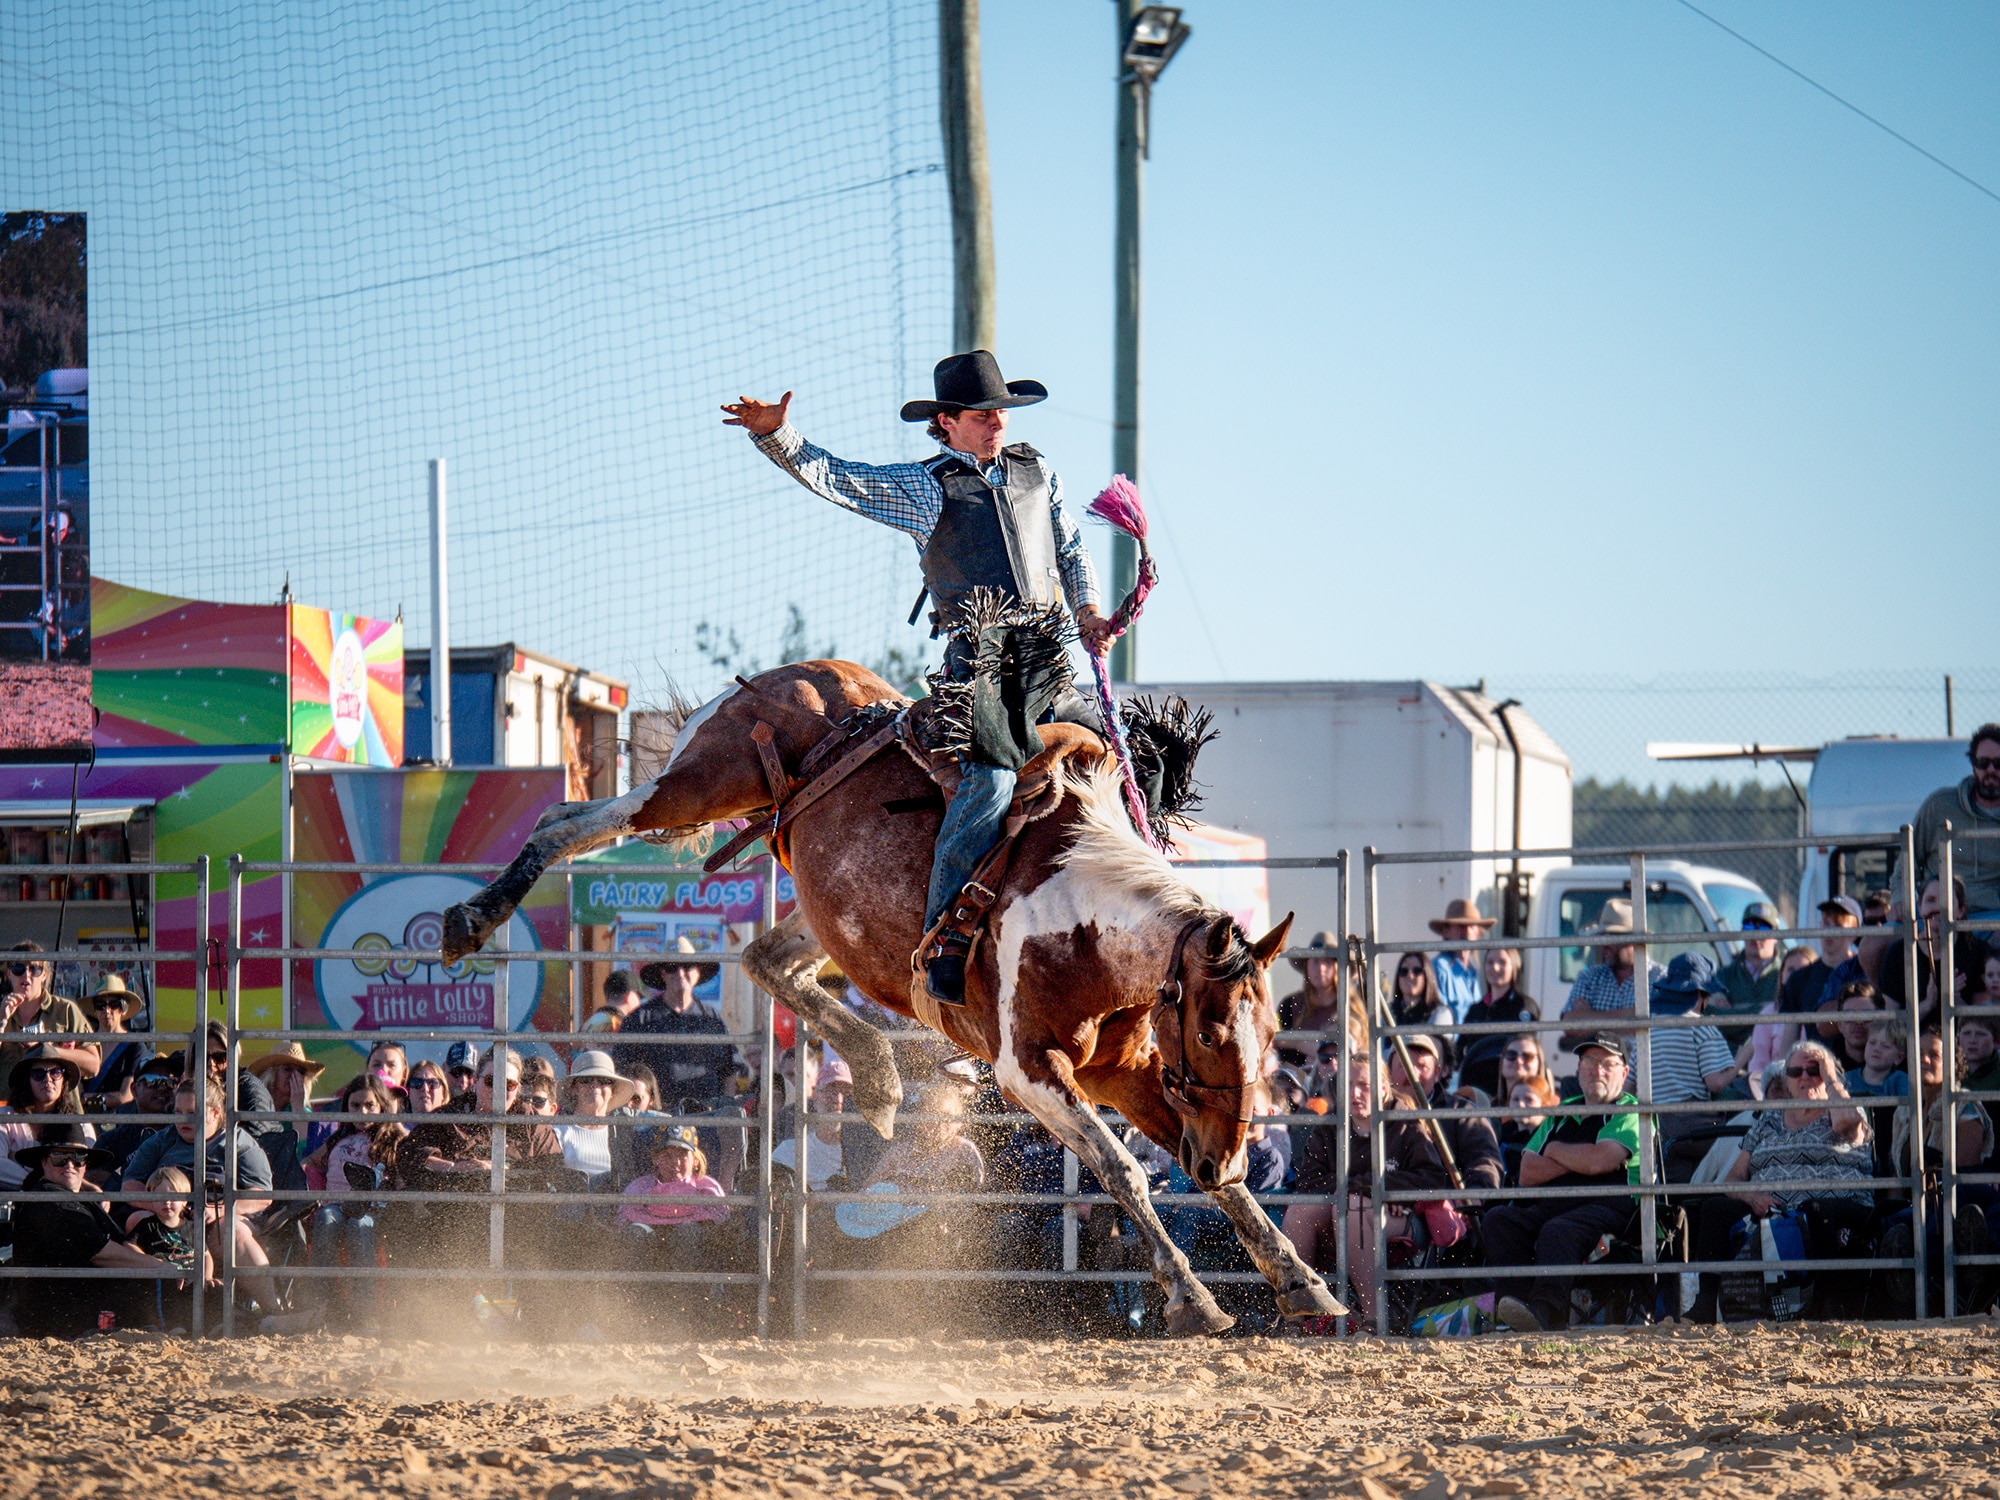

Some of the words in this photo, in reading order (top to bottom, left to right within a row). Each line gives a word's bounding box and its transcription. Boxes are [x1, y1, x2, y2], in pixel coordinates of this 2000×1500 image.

[589, 881, 667, 907] FAIRY
[675, 880, 755, 907] FLOSS
[449, 1013, 485, 1023] SHOP
